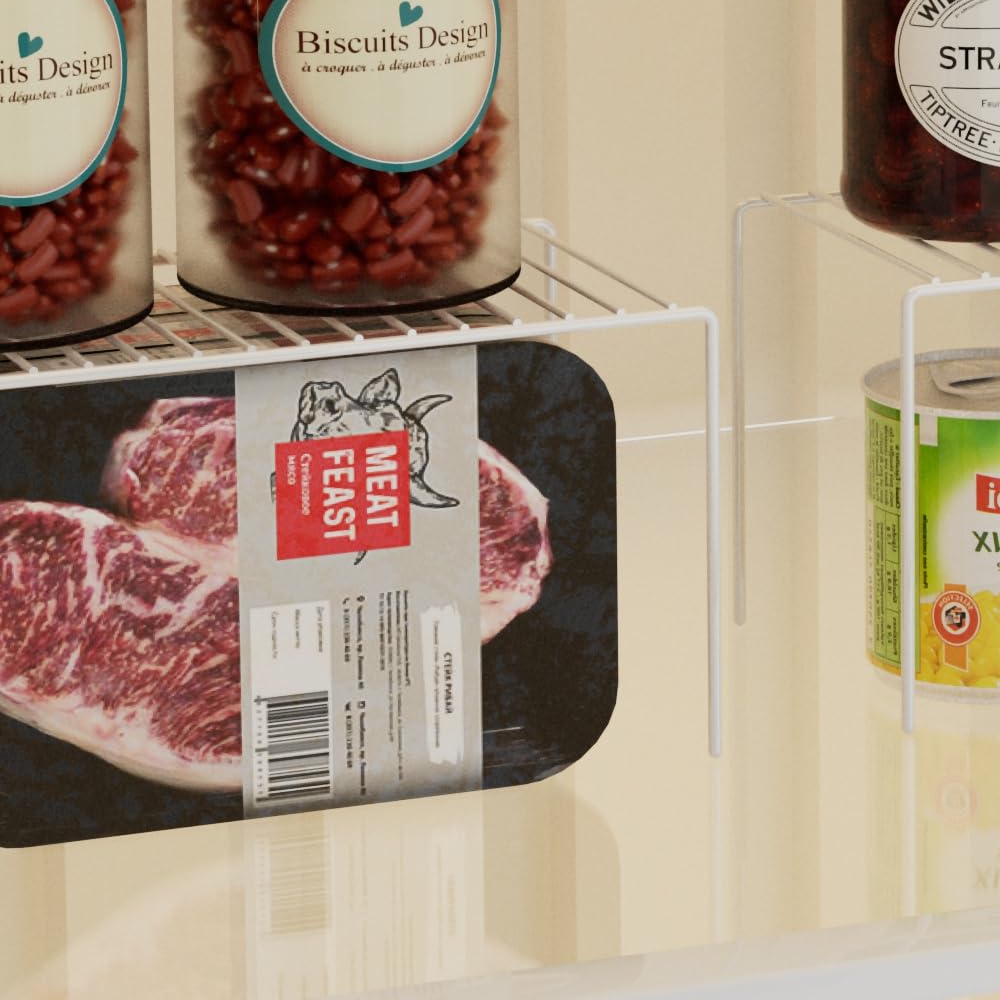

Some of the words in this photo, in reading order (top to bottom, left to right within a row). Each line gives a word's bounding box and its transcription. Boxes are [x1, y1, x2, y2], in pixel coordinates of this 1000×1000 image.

[296, 29, 409, 54] Biscuits
[418, 20, 489, 48] Design
[38, 51, 113, 80] Design
[301, 62, 311, 73] à
[316, 64, 367, 76] croquer
[377, 60, 386, 72] à
[389, 58, 436, 73] déguster
[920, 90, 989, 149] TIPTREE
[323, 448, 356, 541] FEAST
[365, 444, 398, 527] MEAT
